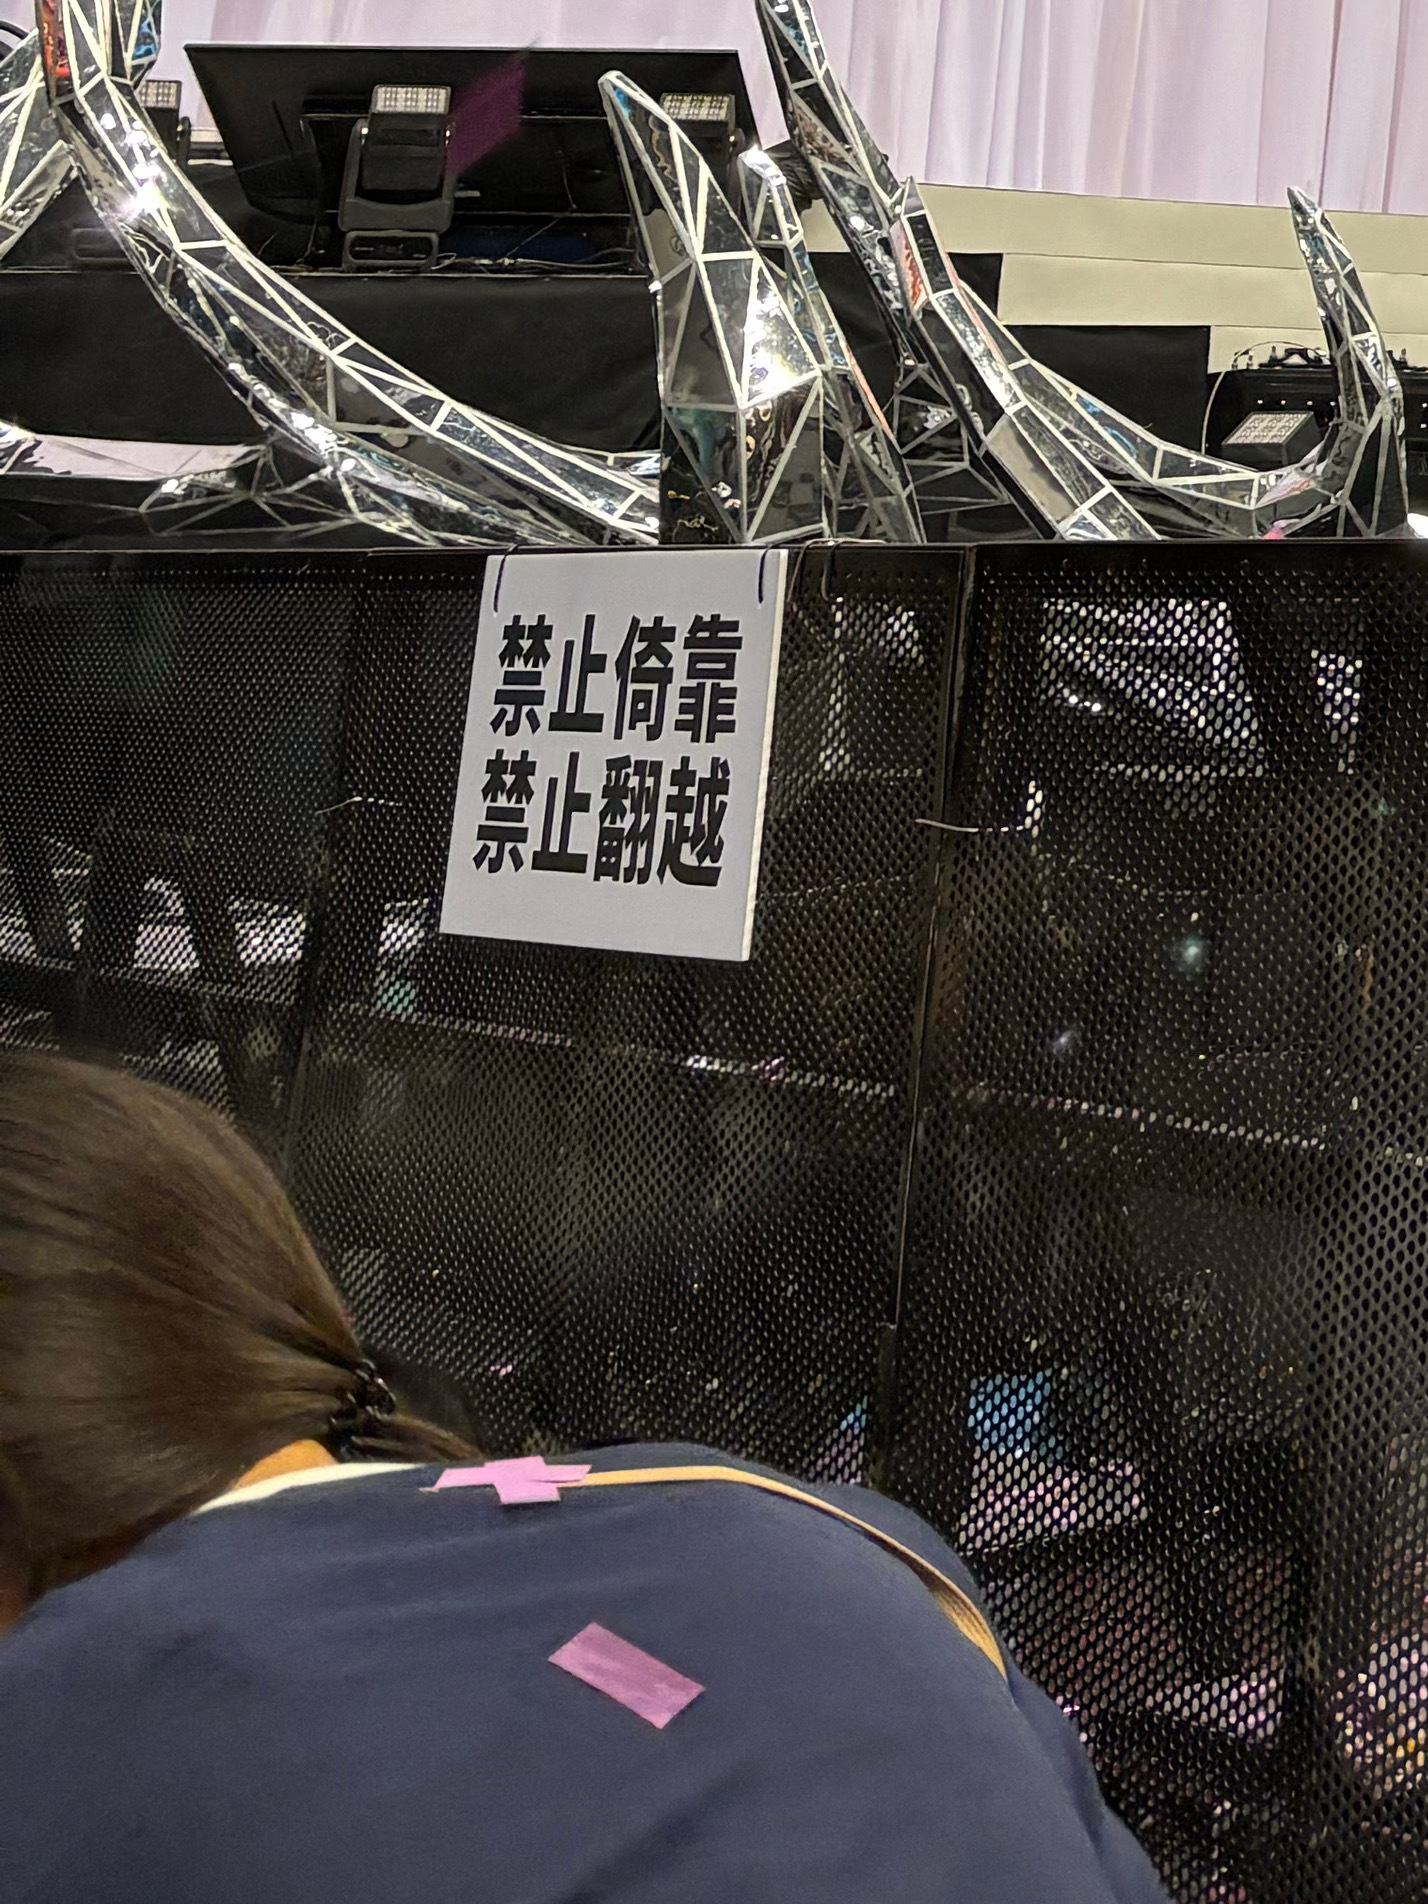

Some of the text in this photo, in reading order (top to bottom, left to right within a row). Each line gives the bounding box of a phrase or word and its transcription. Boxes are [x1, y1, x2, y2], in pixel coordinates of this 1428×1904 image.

[489, 613, 743, 744] 禁止倚靠
[471, 748, 731, 887] 禁止翻越
